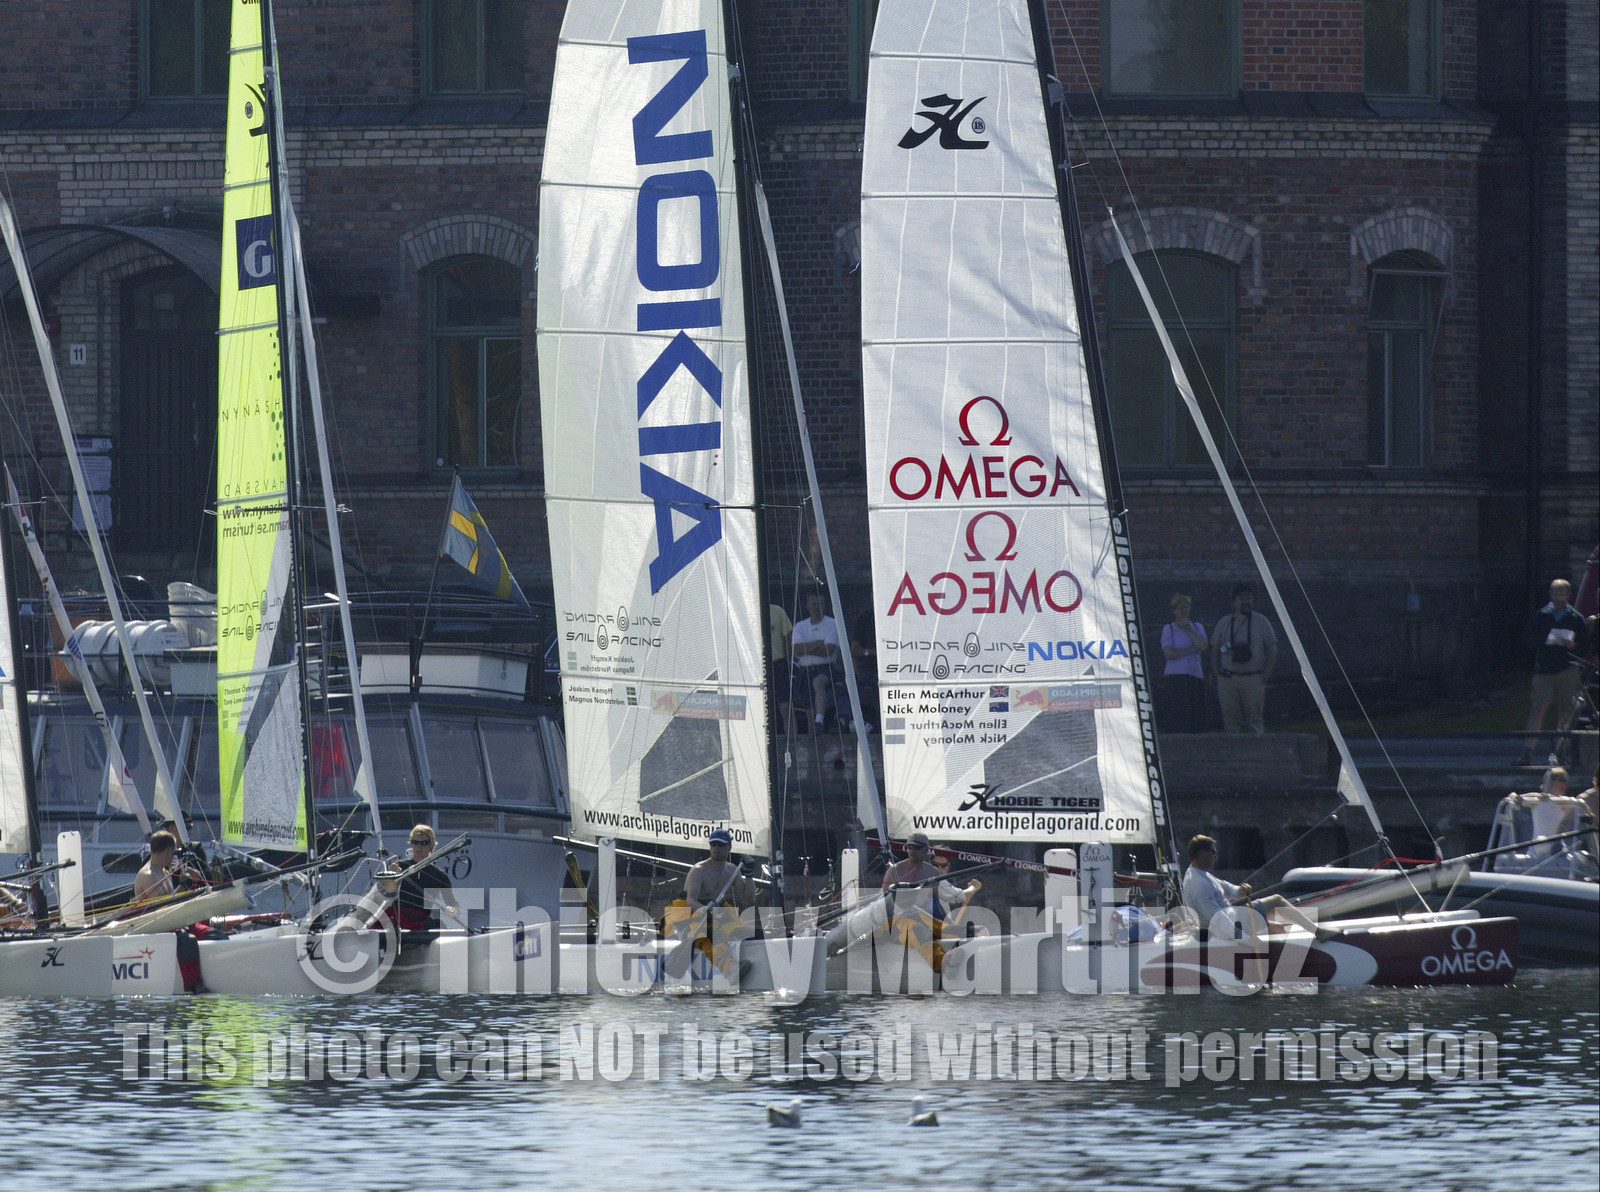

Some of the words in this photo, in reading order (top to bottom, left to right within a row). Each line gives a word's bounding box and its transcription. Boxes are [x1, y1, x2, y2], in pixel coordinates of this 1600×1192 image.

[974, 120, 984, 130] 18
[627, 28, 725, 596] NOKIA
[72, 347, 83, 361] 11
[222, 398, 281, 423] NYNÄSH
[889, 453, 1081, 501] OMEGA
[566, 631, 595, 642] SAIL
[611, 635, 662, 648] RACING
[1028, 639, 1129, 661] NOKIA
[885, 663, 929, 674] SAIL
[954, 663, 1027, 675] RACING
[1111, 515, 1166, 826] ellenmacarthur.com
[568, 685, 591, 693] Joakim
[887, 689, 916, 700] Ellen
[920, 688, 985, 700] MacArthur
[568, 695, 593, 704] Magnus
[887, 704, 914, 715] Nick
[918, 704, 972, 716] Moloney
[994, 795, 1043, 807] HOBIE
[1050, 796, 1100, 807] TIGER
[584, 808, 753, 844] www.archipelagoraicom
[912, 813, 1140, 835] www.archipelagoraid.com
[966, 853, 992, 865] OMEGA
[1022, 862, 1048, 873] OMEGA
[1421, 948, 1514, 977] OMEGA
